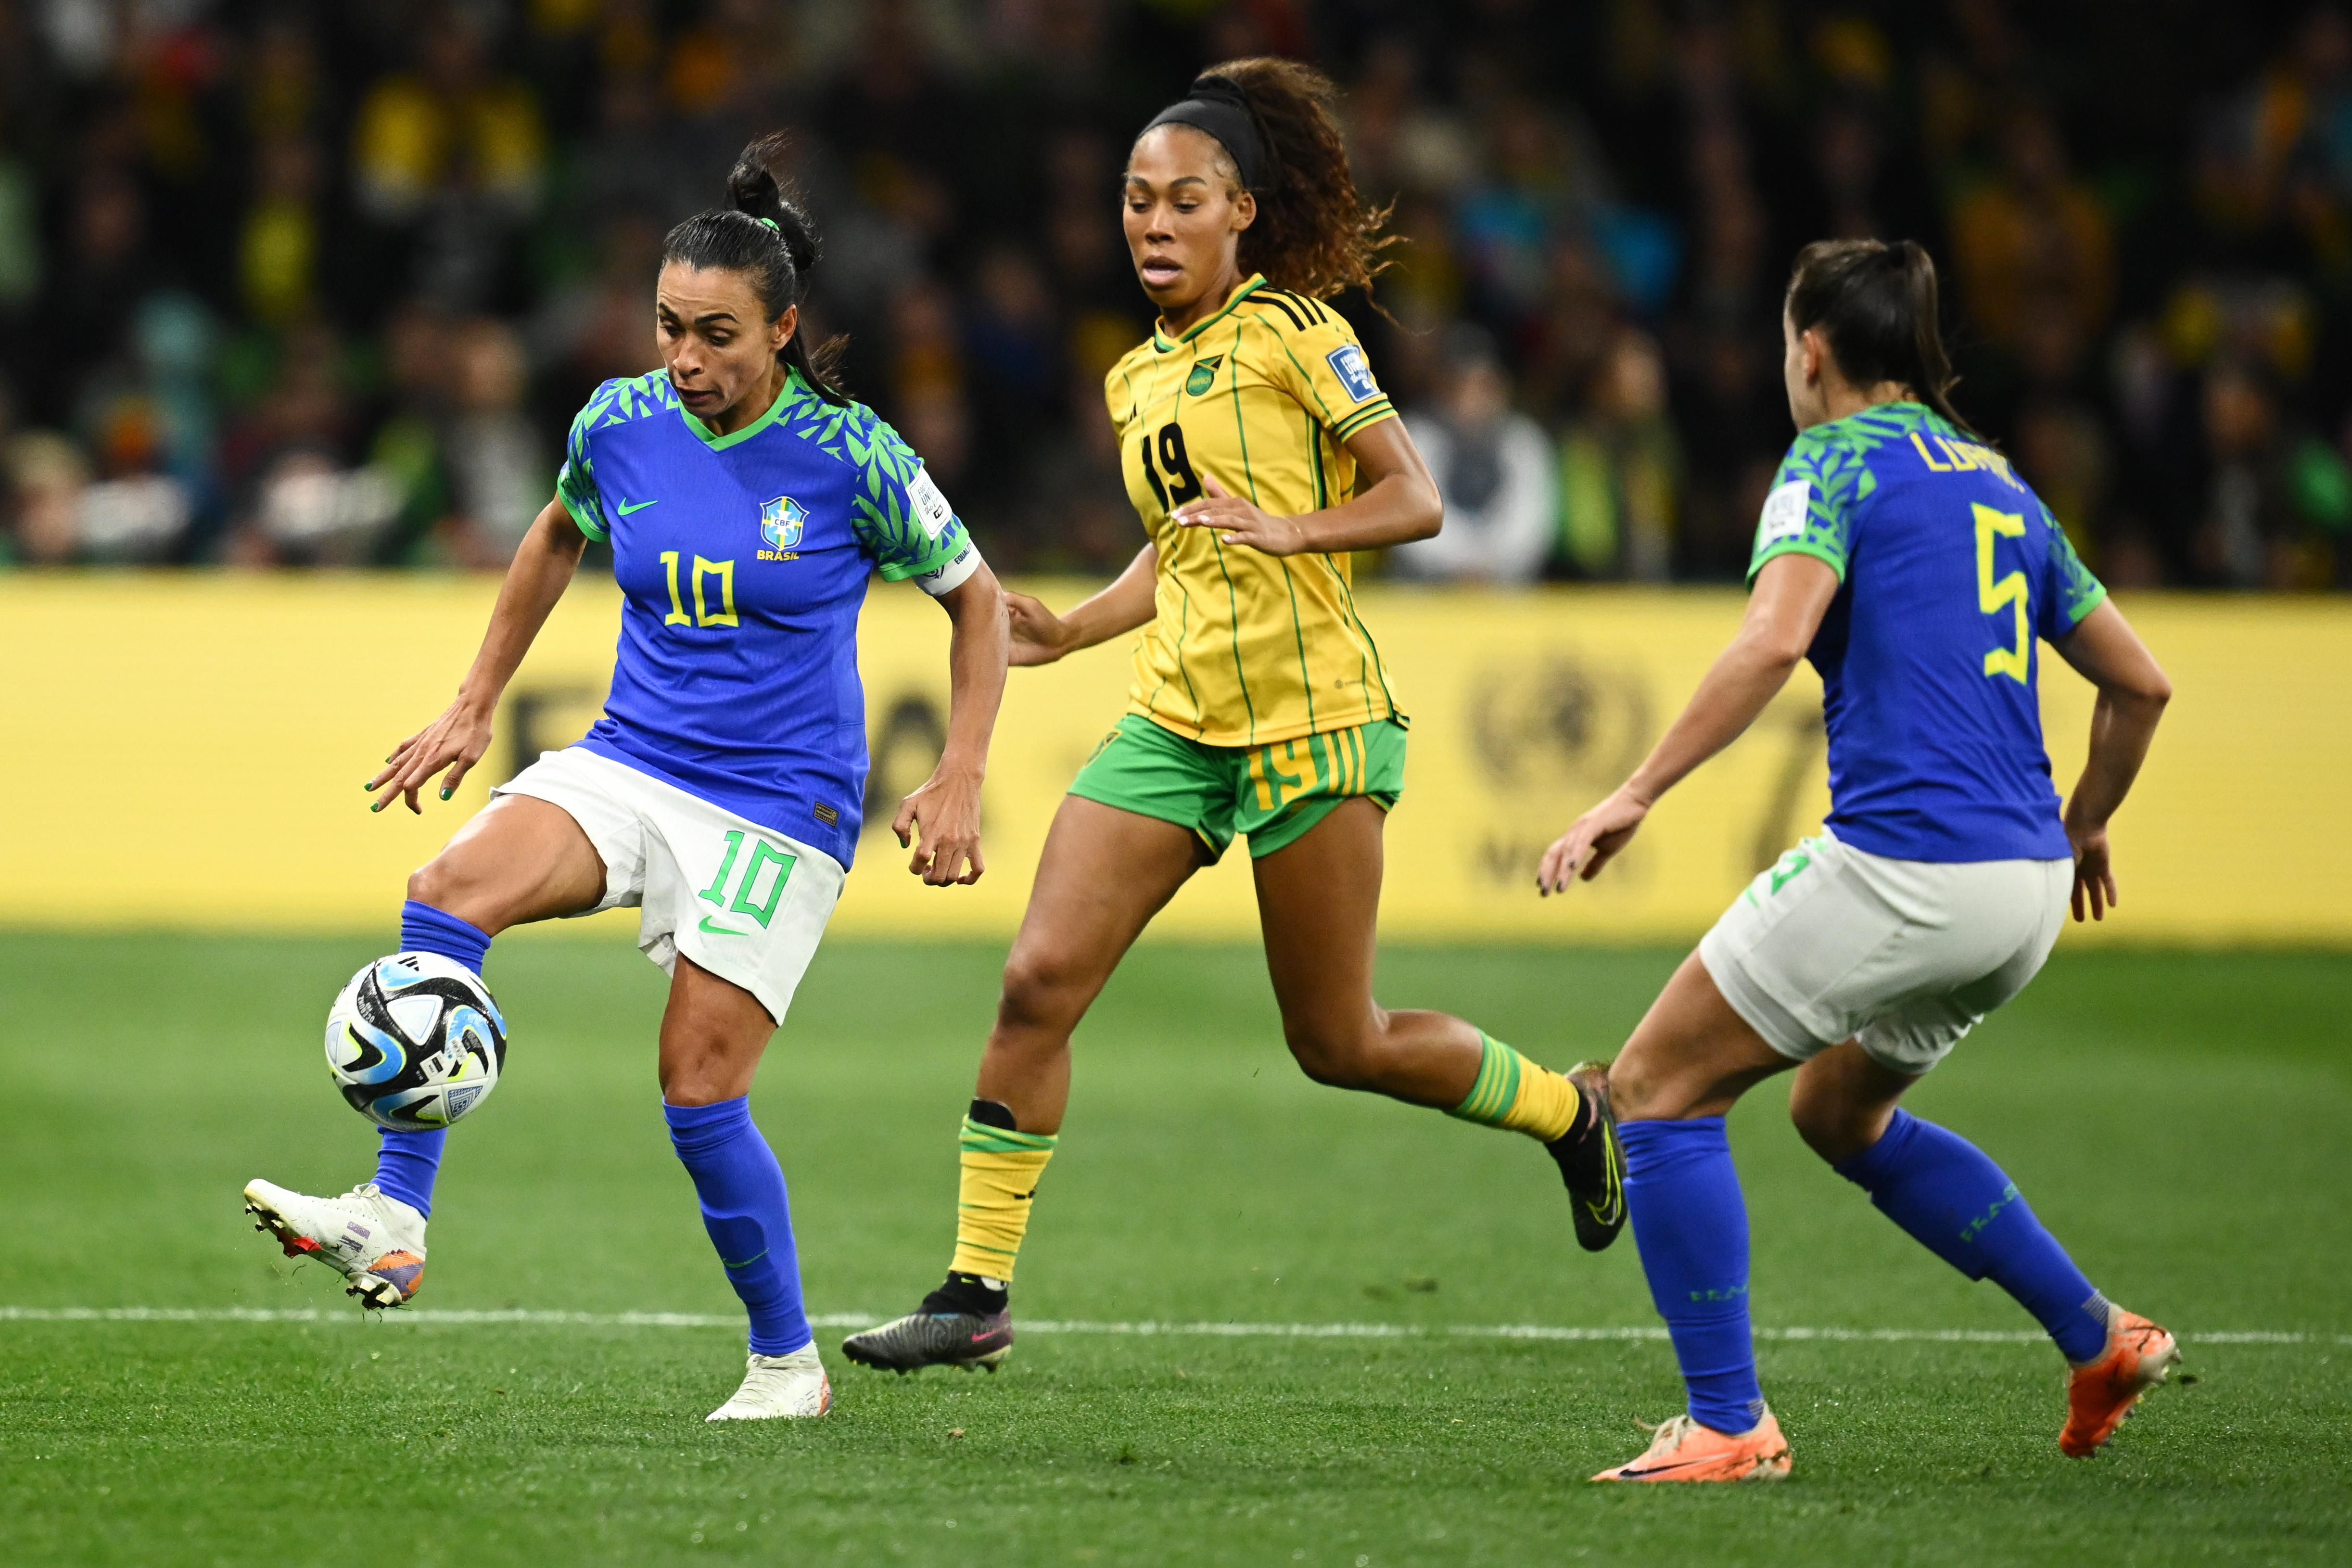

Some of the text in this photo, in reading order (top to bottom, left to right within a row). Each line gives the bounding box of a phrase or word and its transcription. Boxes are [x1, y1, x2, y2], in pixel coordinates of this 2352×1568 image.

[1142, 422, 1203, 513] 19
[659, 550, 739, 627] 10
[757, 549, 800, 561] BRASIL
[1971, 502, 2029, 685] 5
[1246, 737, 1318, 811] 19
[698, 830, 797, 929] 10
